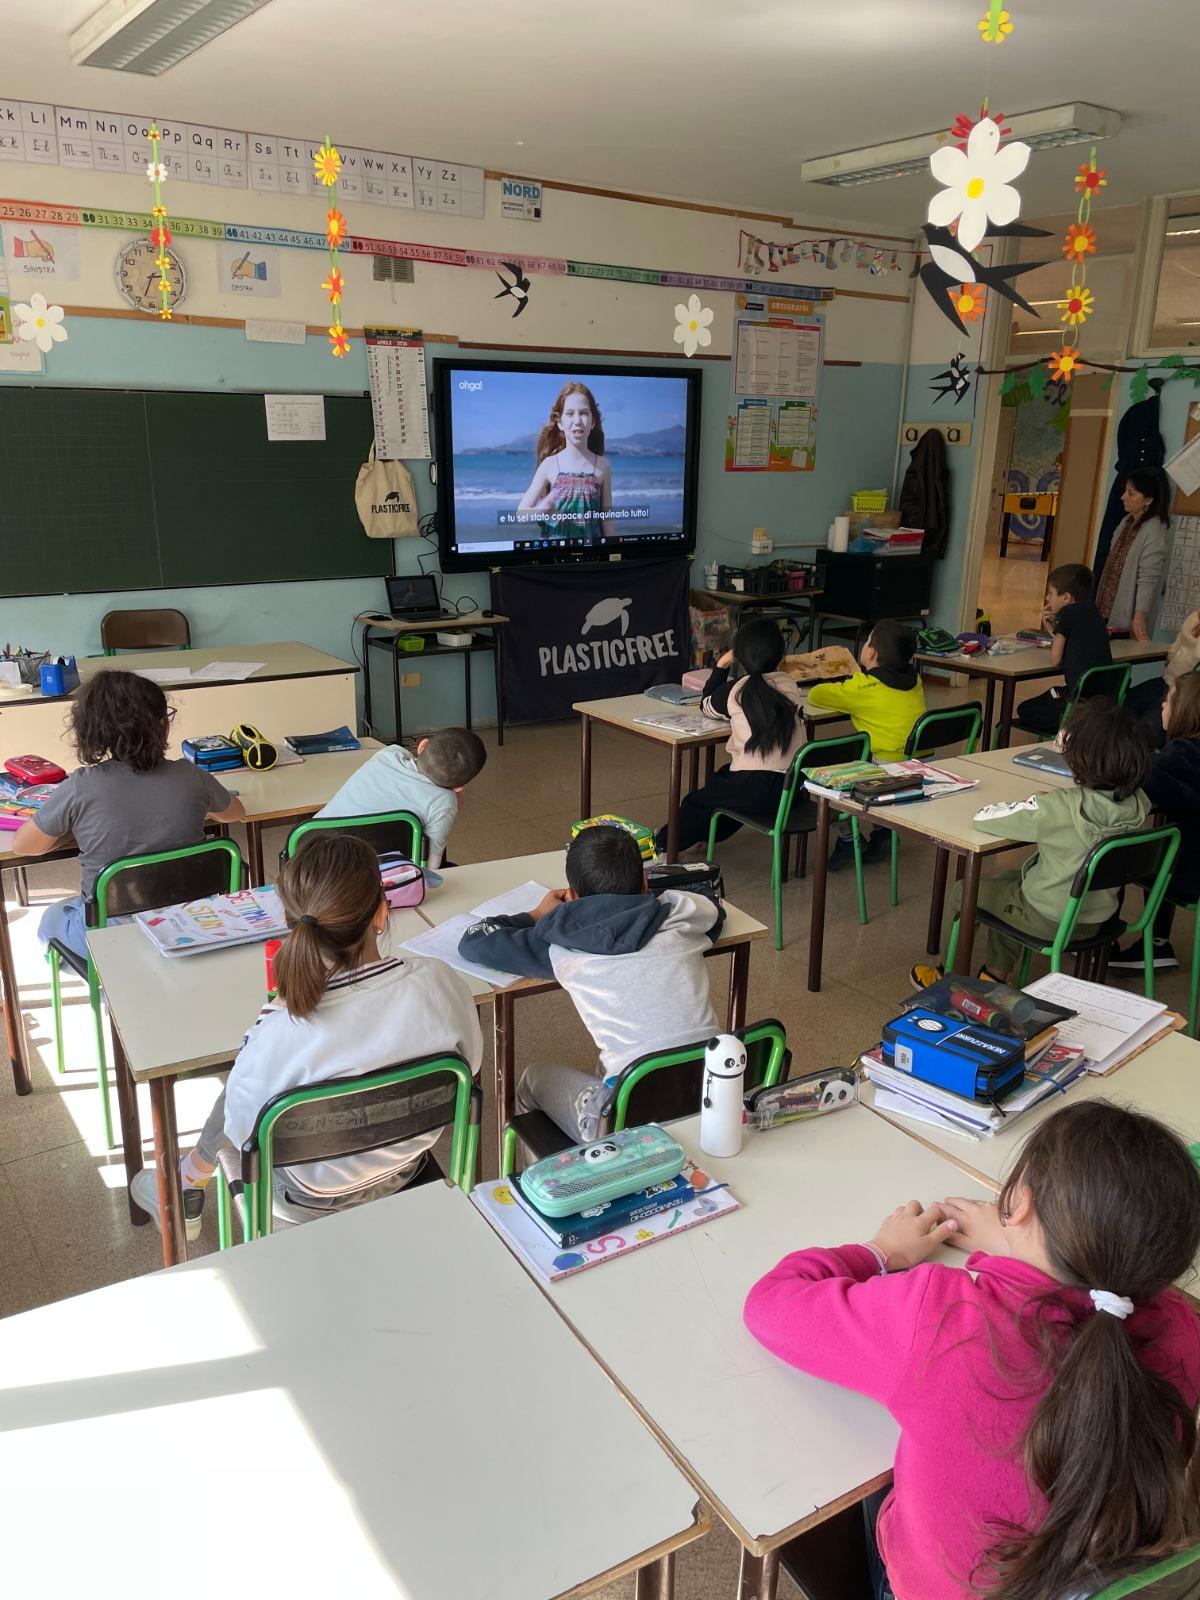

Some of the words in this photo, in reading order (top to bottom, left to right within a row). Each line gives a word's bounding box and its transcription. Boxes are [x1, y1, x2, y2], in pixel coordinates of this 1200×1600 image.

[503, 182, 540, 199] NORD
[3, 206, 15, 216] 25
[20, 208, 32, 217] 26
[35, 210, 47, 218] 27
[51, 211, 63, 220] 28
[67, 212, 78, 222] 29
[98, 215, 109, 224] 31
[113, 217, 124, 226] 32
[127, 218, 138, 226] 33
[142, 219, 153, 228] 34
[170, 222, 180, 231] 36
[184, 223, 195, 232] 37
[198, 225, 209, 234] 38
[212, 227, 222, 236] 39
[240, 230, 249, 239] 41
[252, 231, 262, 240] 42
[266, 232, 276, 241] 43
[278, 234, 288, 242] 44
[291, 235, 300, 244] 45
[304, 236, 313, 245] 46
[316, 238, 326, 246] 47
[399, 247, 408, 255] 54
[410, 248, 419, 256] 55
[422, 249, 430, 258] 56
[459, 380, 482, 391] ohga!
[507, 514, 515, 522] tu
[517, 513, 529, 522] sei
[530, 512, 549, 521] stato
[551, 512, 582, 522] capace
[584, 511, 592, 519] di
[593, 510, 629, 521] inquinarlo
[630, 509, 649, 517] tutto!
[538, 629, 679, 677] PLASTICFREE
